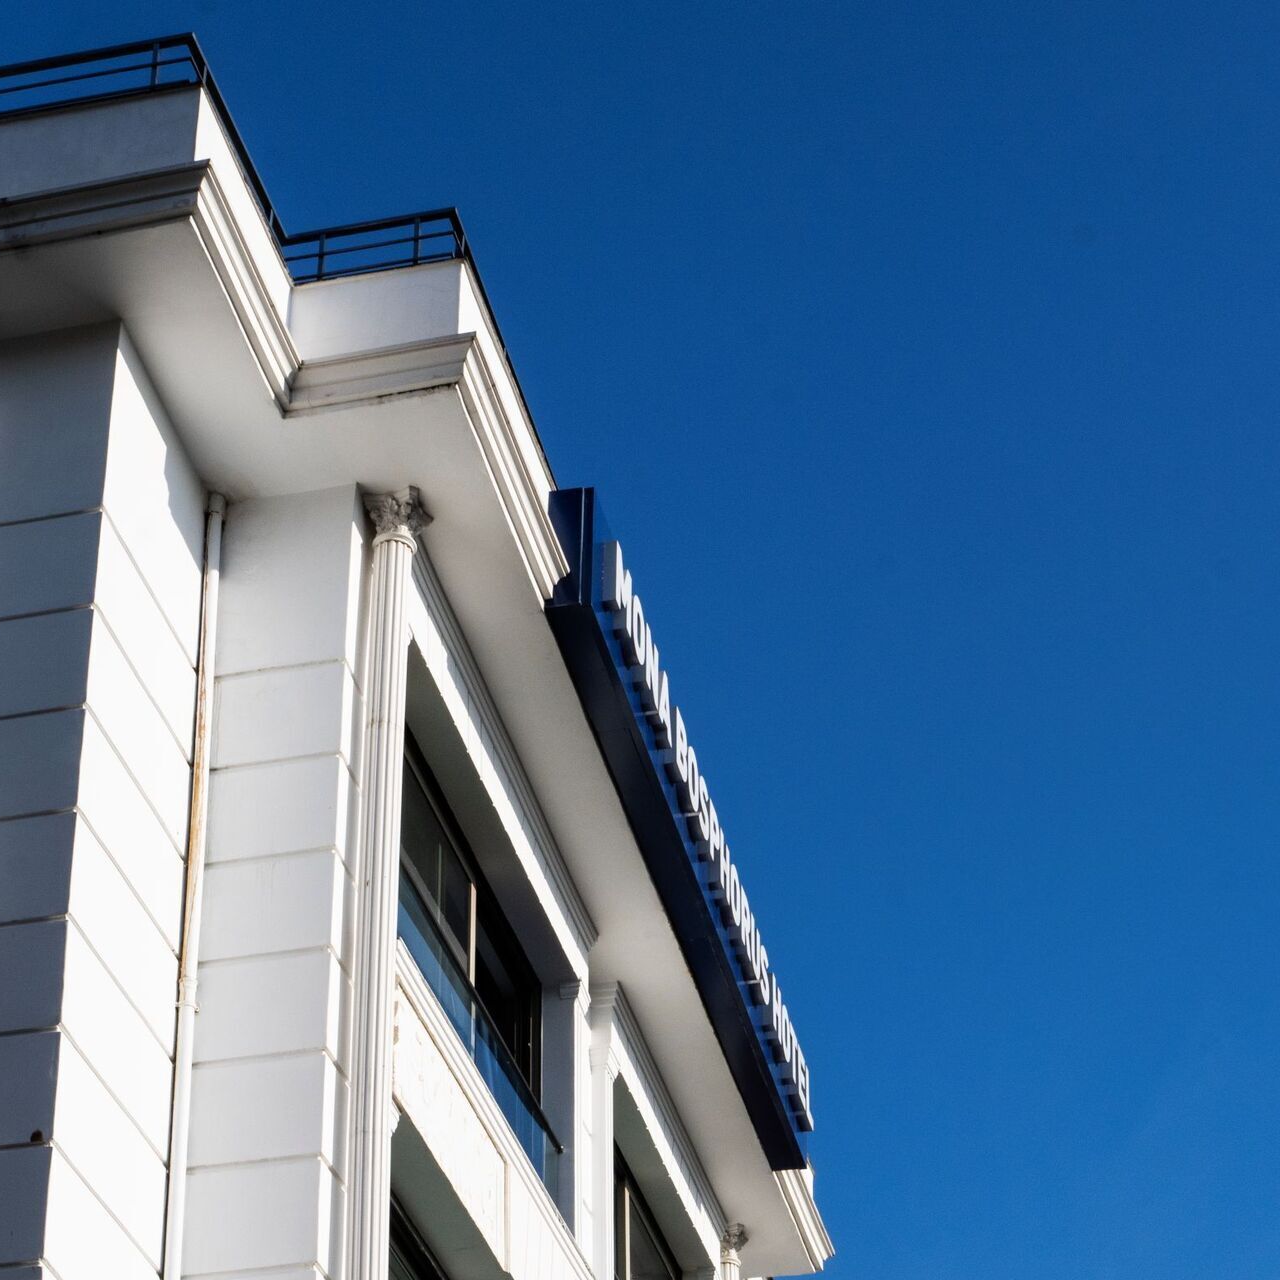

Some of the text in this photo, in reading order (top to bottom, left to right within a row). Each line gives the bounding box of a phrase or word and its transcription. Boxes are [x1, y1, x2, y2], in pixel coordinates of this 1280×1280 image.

[615, 539, 814, 1132] MONA BOSPHORUS HOTEL
